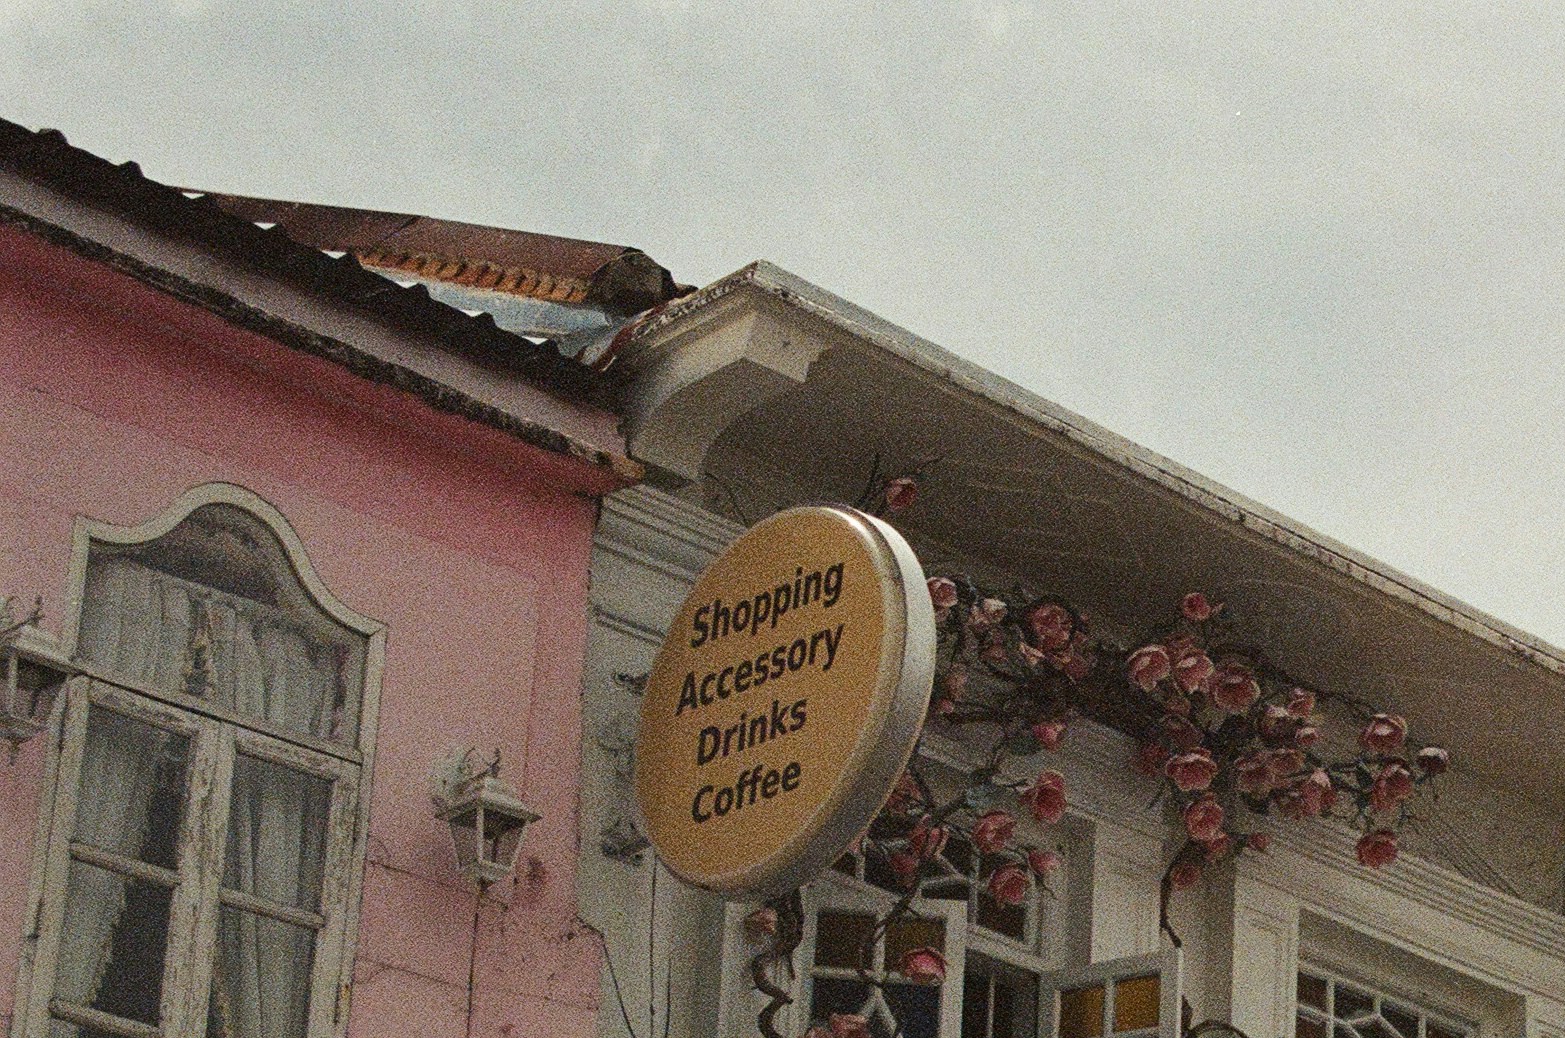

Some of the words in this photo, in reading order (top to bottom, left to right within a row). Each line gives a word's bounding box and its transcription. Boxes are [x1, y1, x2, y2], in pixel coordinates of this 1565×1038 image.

[691, 563, 844, 649] Shopping
[675, 624, 843, 715] Accessory
[696, 698, 807, 766] Drinks
[692, 760, 801, 823] Coffee
